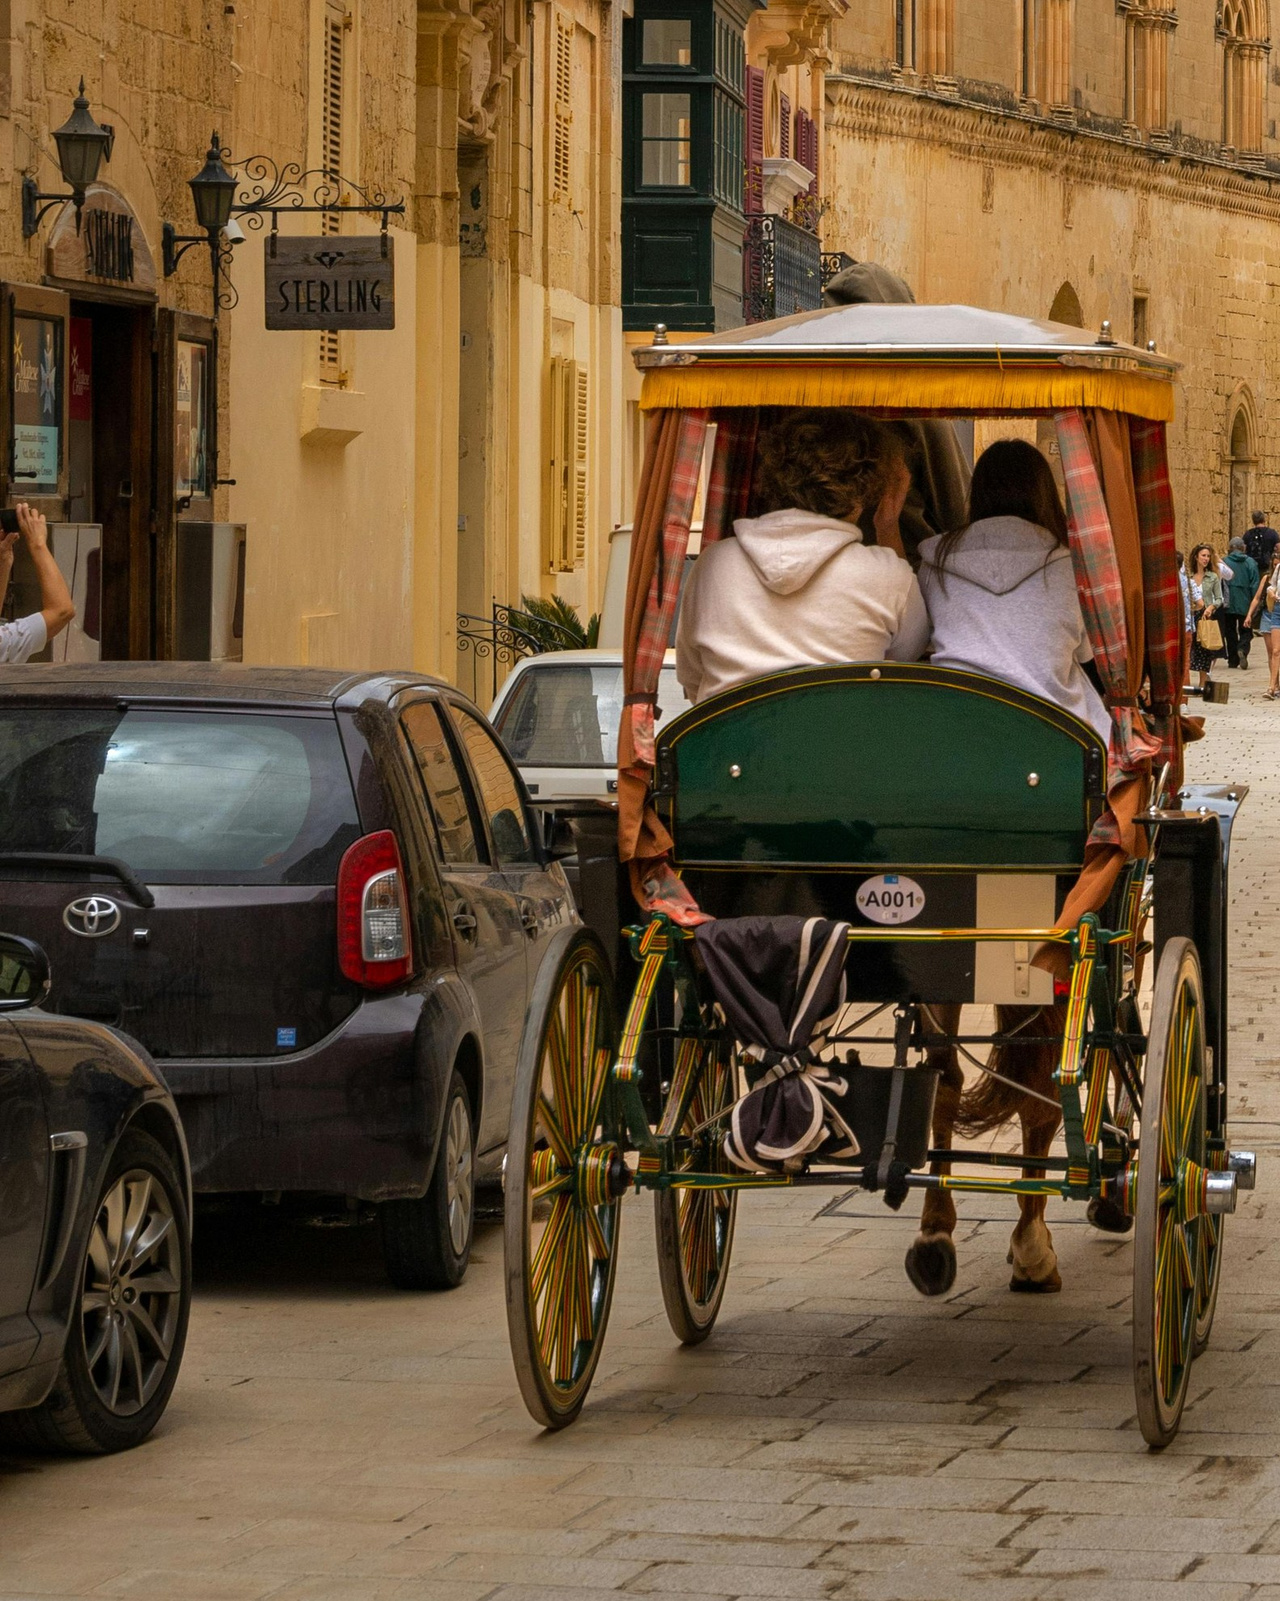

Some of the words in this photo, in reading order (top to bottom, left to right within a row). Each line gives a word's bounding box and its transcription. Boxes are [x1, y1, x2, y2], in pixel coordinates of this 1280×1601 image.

[84, 208, 134, 283] STERLING
[279, 279, 382, 313] STERLING
[864, 890, 914, 908] A001
